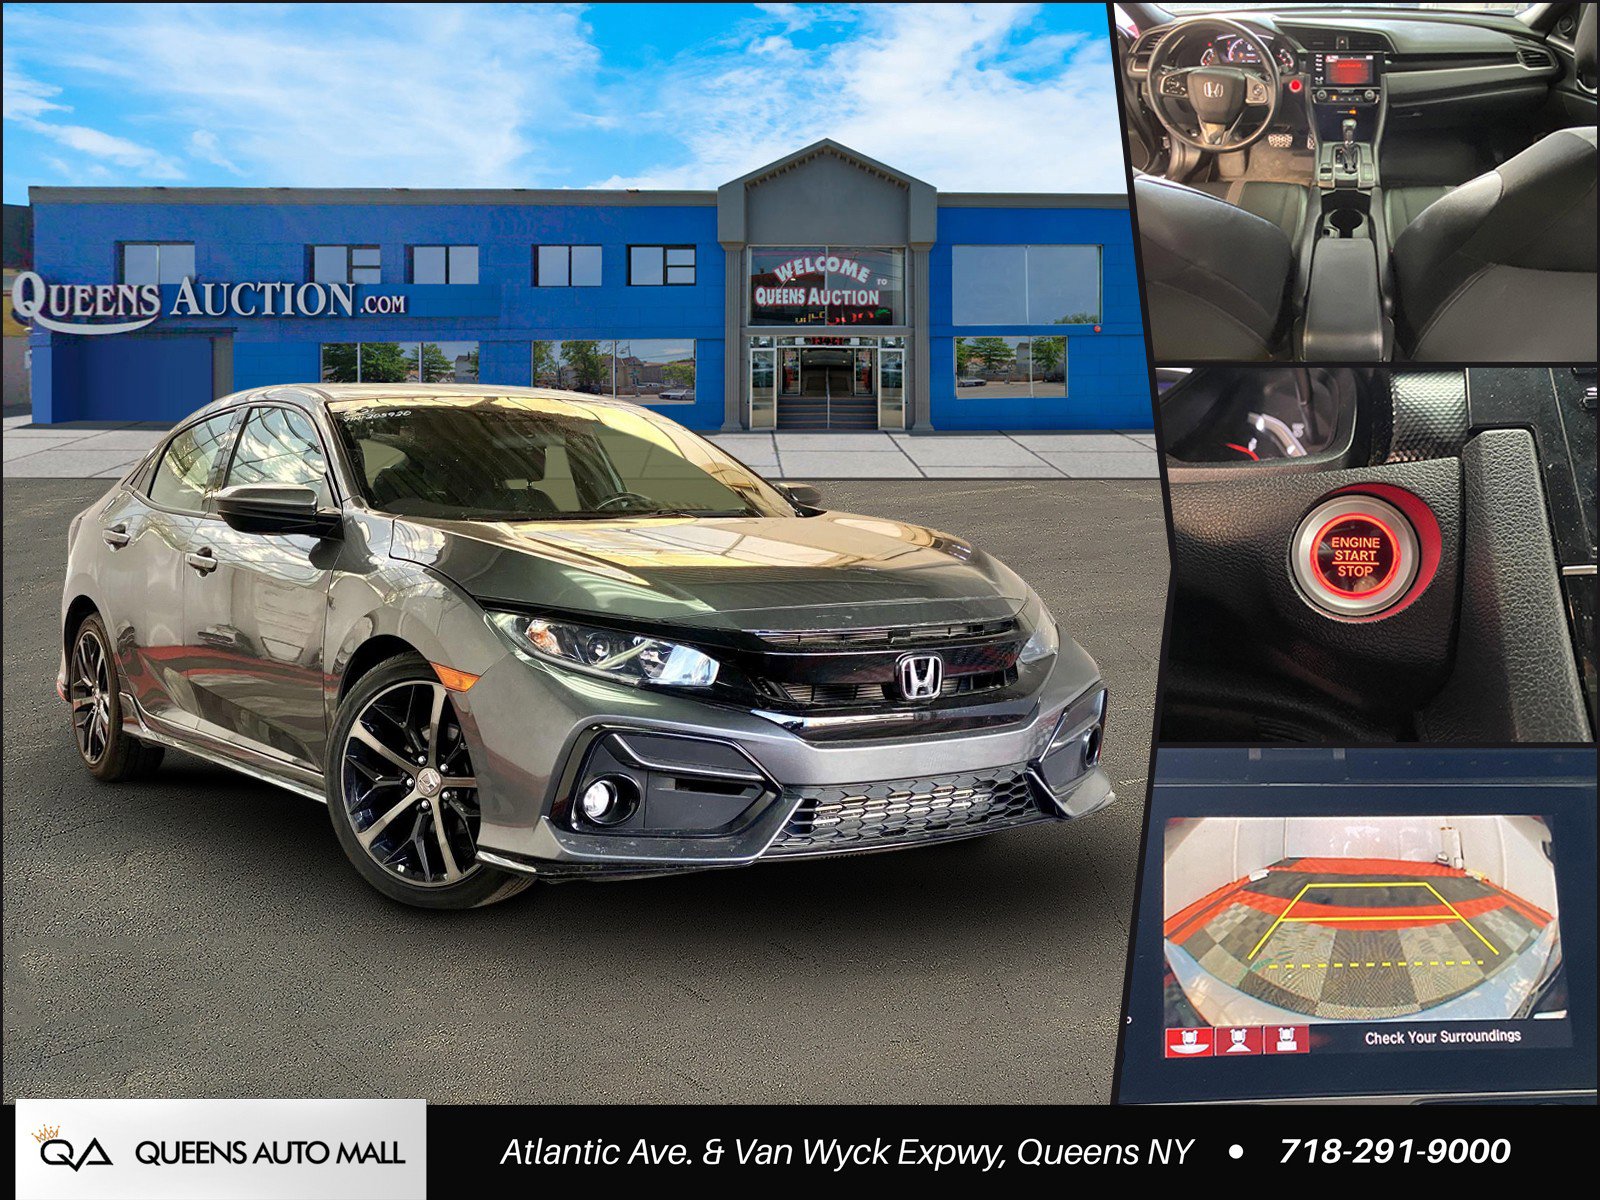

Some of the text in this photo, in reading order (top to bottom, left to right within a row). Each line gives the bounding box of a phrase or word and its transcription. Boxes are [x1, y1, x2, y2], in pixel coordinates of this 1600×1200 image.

[773, 255, 888, 286] WELCOME TO
[12, 271, 161, 335] QUEENS
[755, 286, 880, 307] QUEENS AUCTION
[1331, 537, 1381, 548] ENGINE
[1334, 550, 1377, 562] START
[1338, 565, 1374, 577] STOP
[1365, 1029, 1522, 1045] Check Your Surroundings
